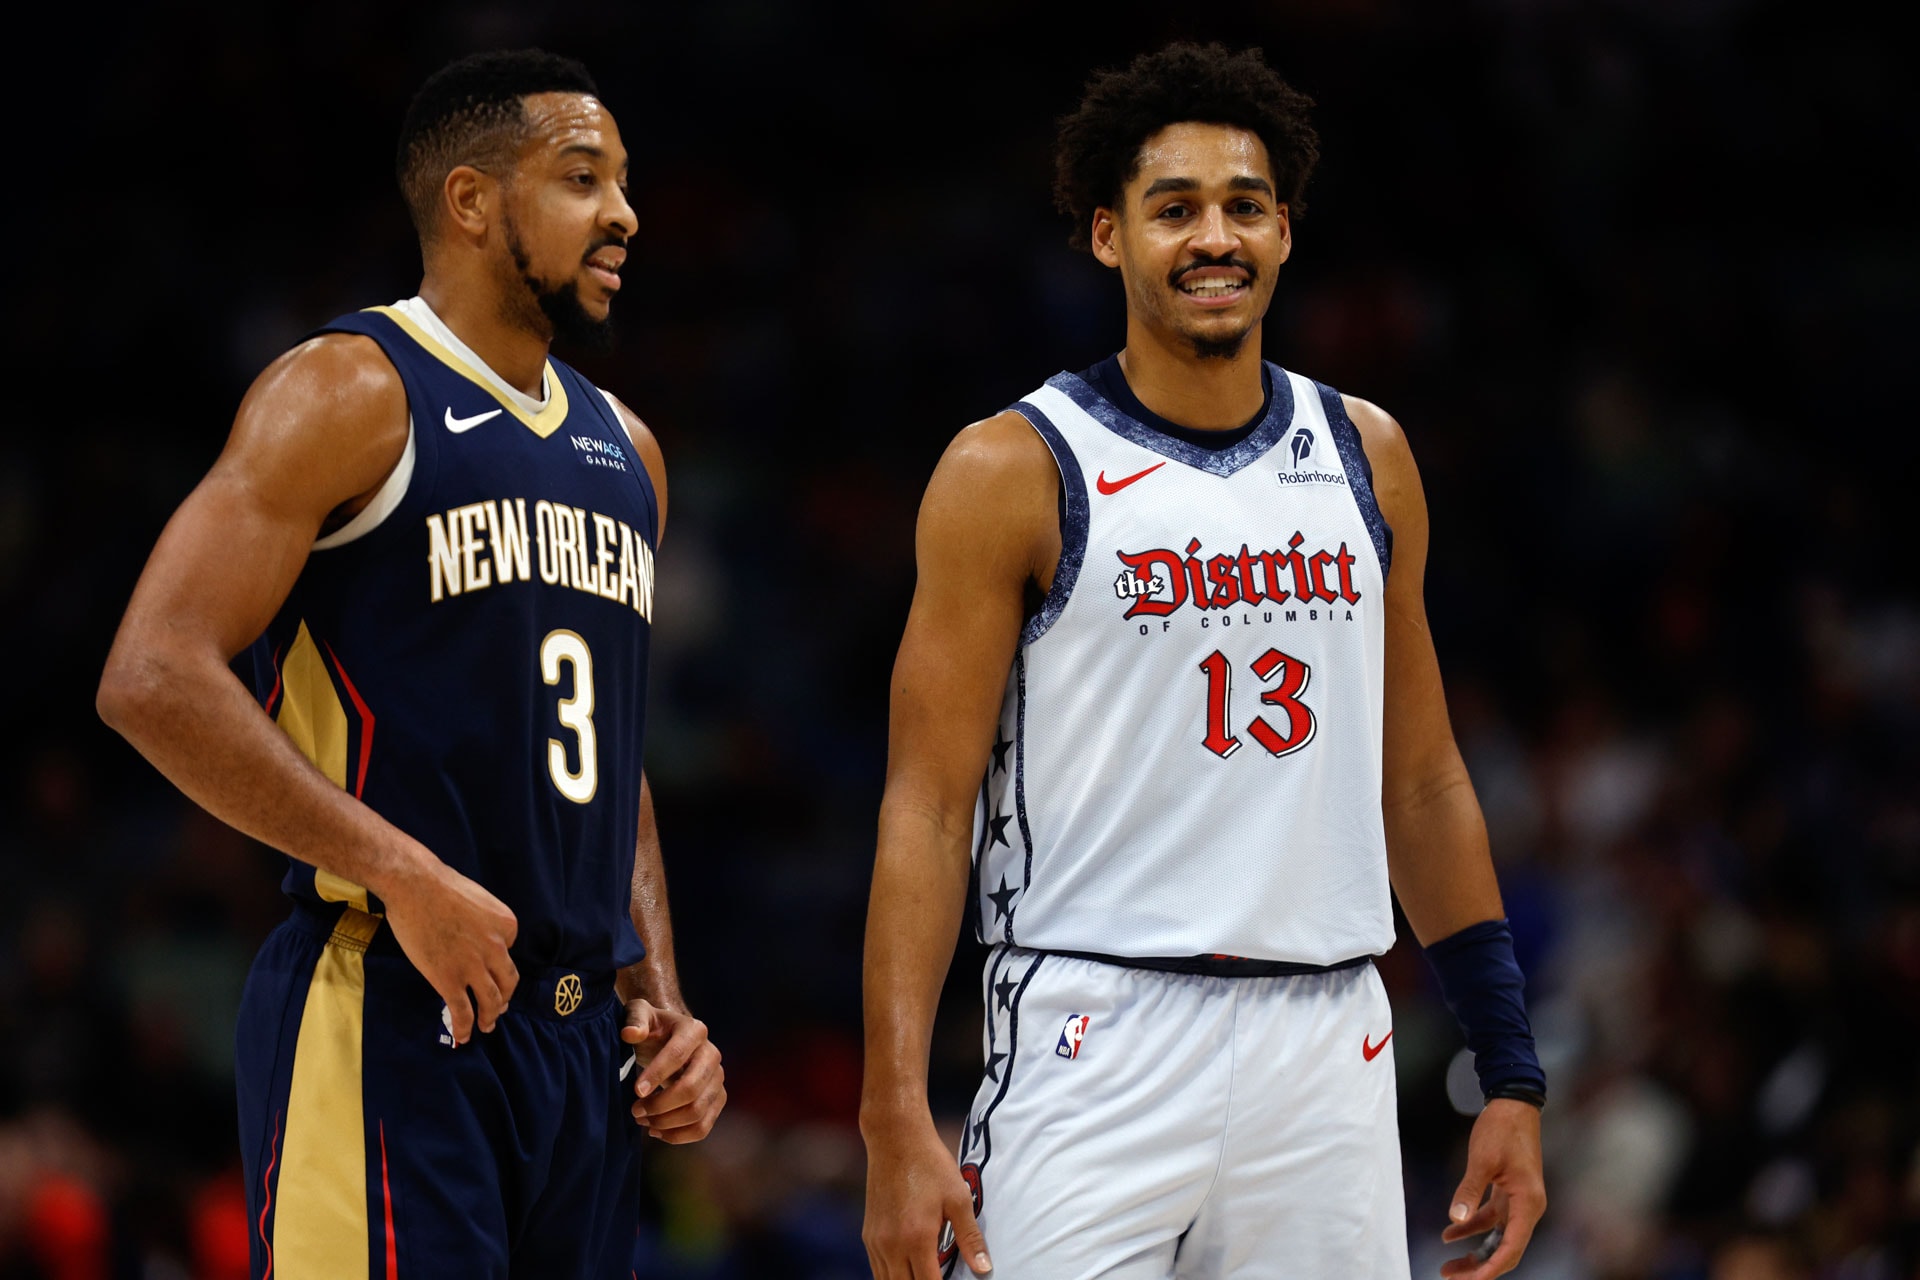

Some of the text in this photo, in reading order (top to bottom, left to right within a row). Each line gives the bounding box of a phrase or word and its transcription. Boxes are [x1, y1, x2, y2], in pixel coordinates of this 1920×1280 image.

[586, 454, 626, 472] GARAGE
[1278, 470, 1346, 485] Robinhood
[426, 498, 532, 603] NEW
[1114, 530, 1362, 621] the District
[1139, 609, 1354, 636] OF COLUMBIA
[540, 628, 599, 804] 3
[1199, 648, 1318, 758] 13
